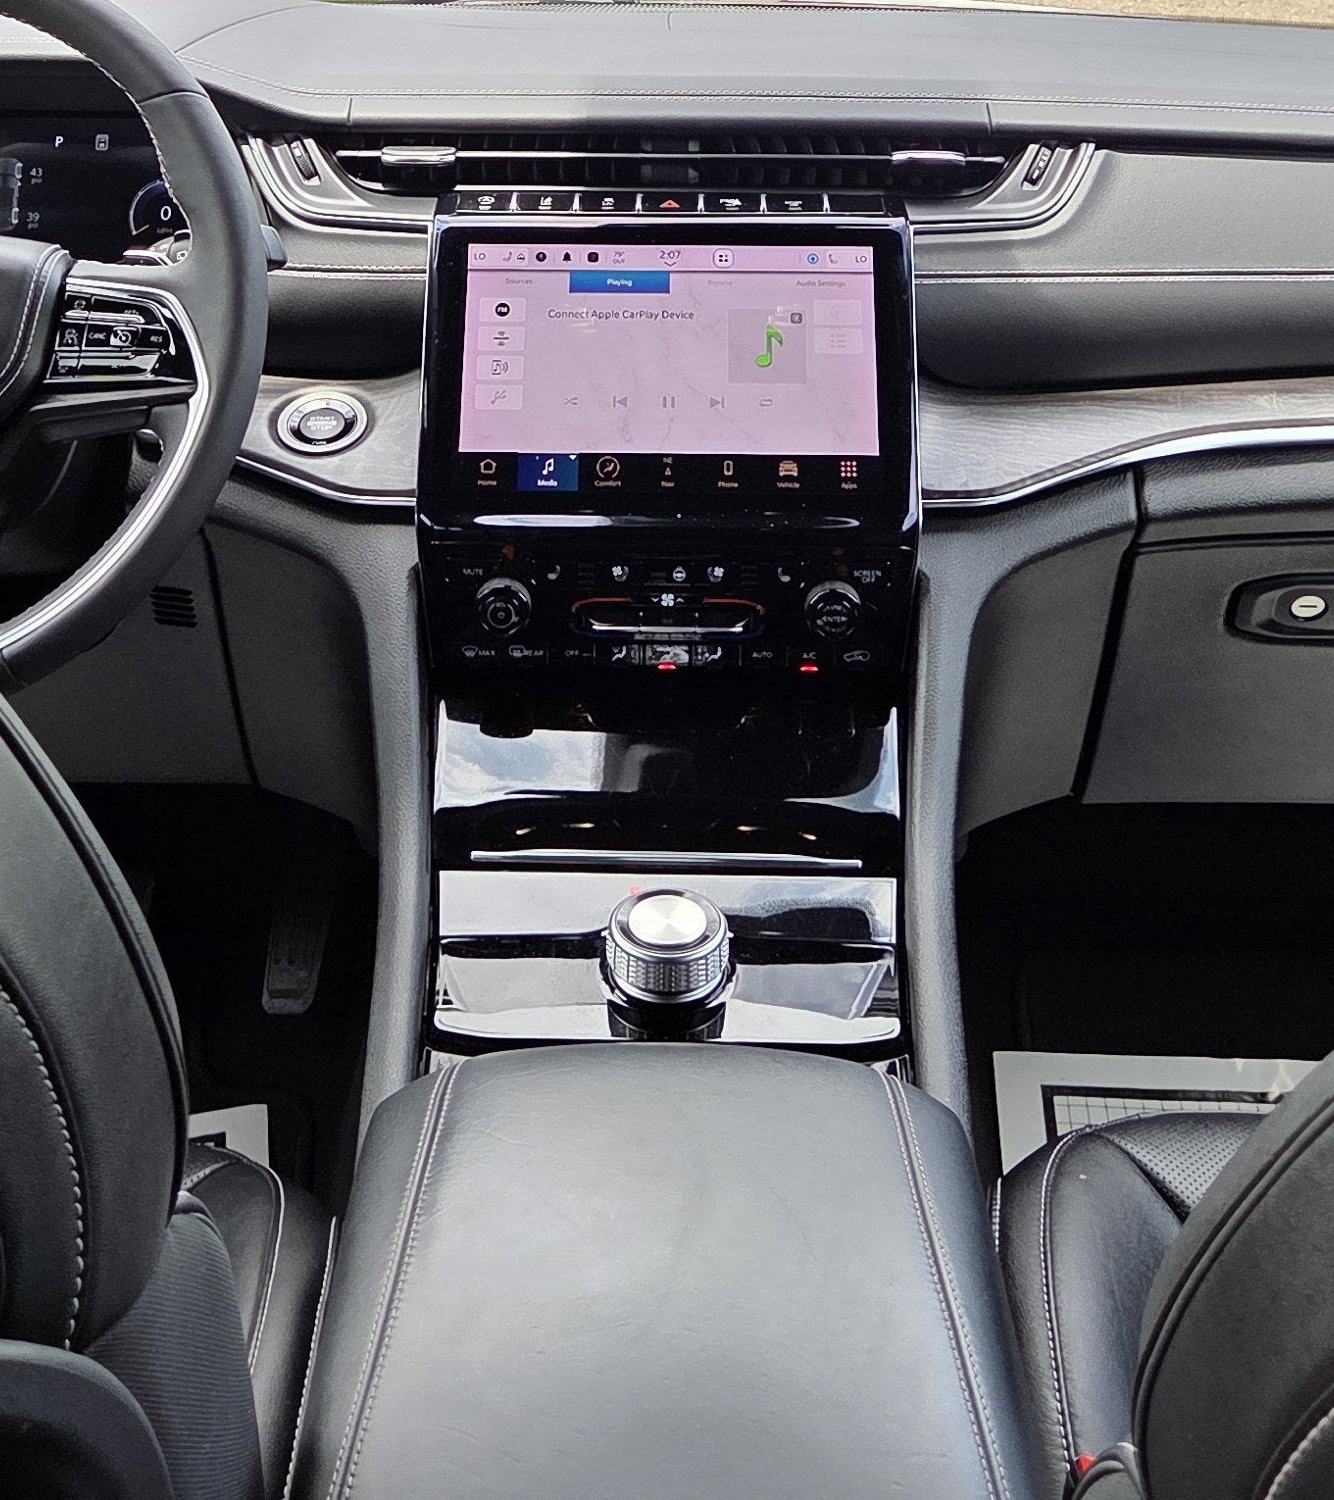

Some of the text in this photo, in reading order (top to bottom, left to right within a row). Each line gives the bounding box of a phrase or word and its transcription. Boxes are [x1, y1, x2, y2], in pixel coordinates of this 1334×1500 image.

[55, 136, 64, 147] P
[29, 168, 43, 177] 43
[27, 213, 40, 222] 39
[160, 205, 172, 221] 0
[473, 252, 486, 261] LO
[659, 250, 681, 260] 2:07
[855, 255, 867, 263] LO
[606, 278, 633, 288] Playing
[795, 279, 846, 288] Audio Settings
[547, 308, 695, 322] Connect Apple CarPlay Device
[537, 479, 558, 487] Media
[594, 479, 622, 488] Comfort
[462, 567, 484, 577] MUTE
[478, 649, 496, 657] MAX
[565, 649, 580, 657] OFF
[751, 651, 773, 660] AUTO
[801, 651, 817, 660] A/C
